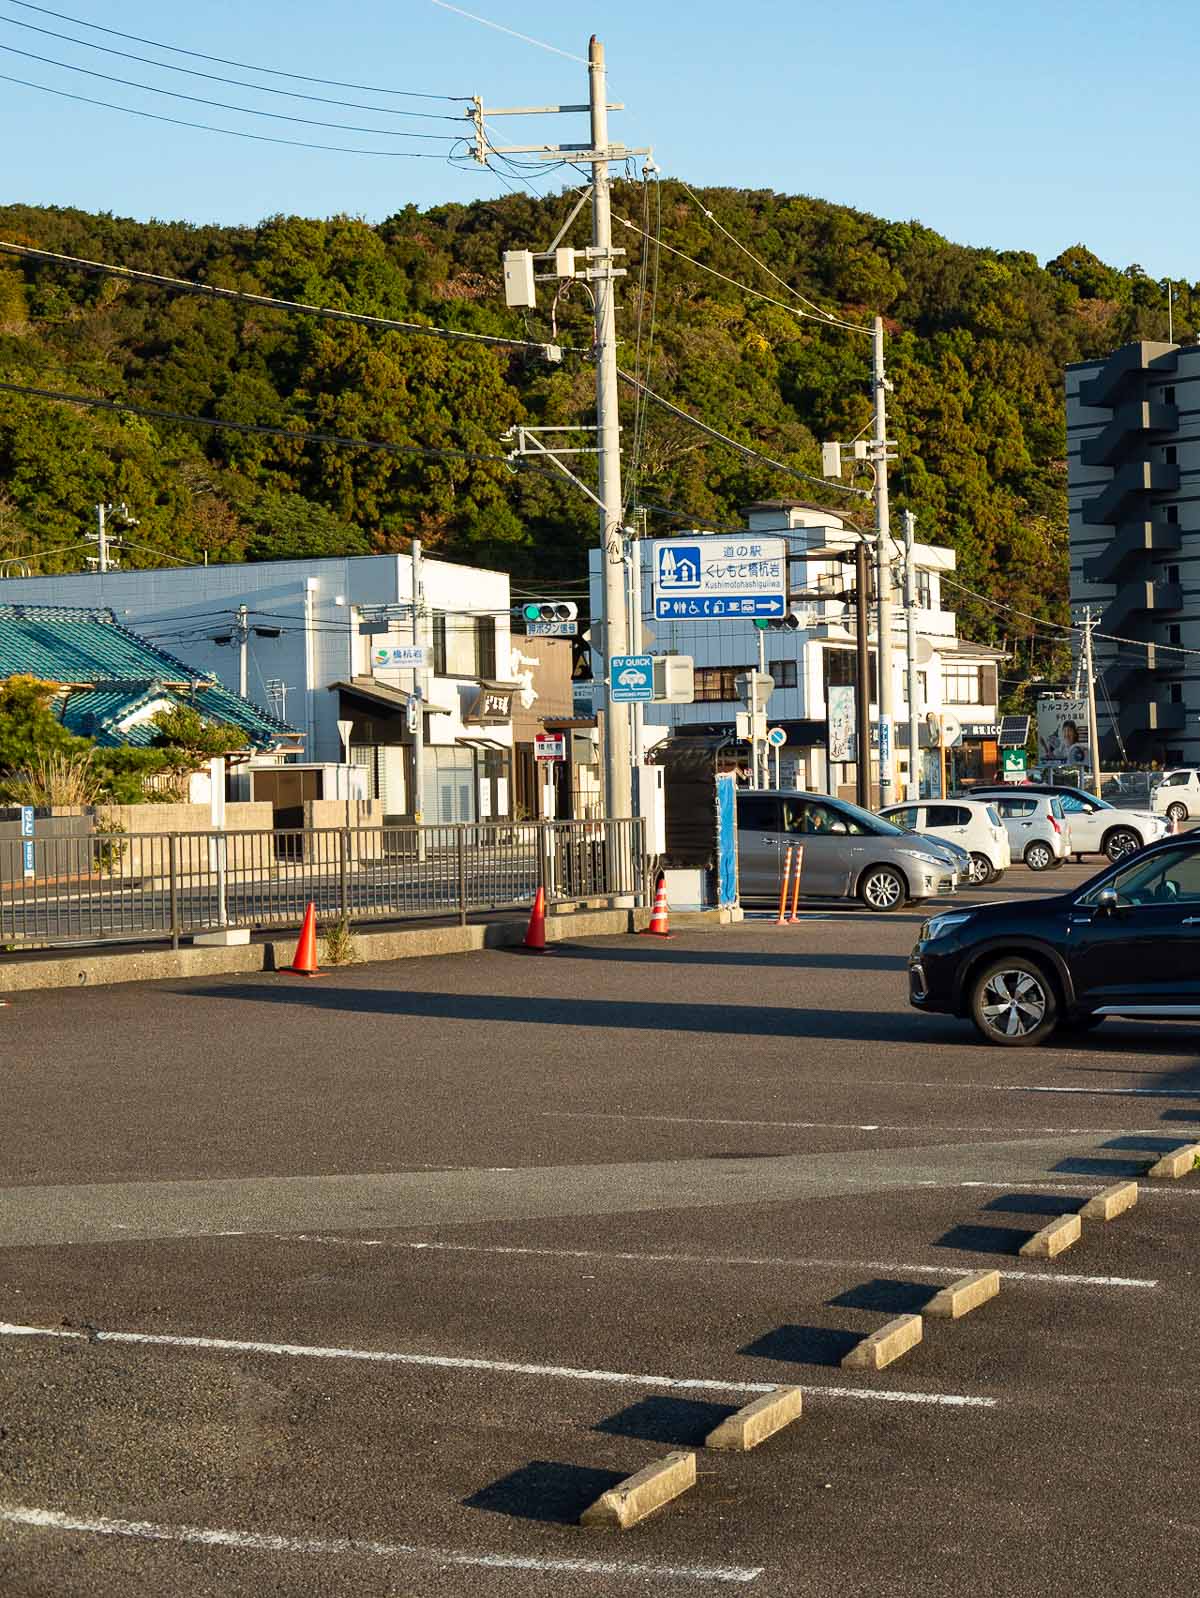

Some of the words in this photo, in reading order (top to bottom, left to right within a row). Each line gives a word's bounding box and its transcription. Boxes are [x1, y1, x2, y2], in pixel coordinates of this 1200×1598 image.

[724, 545, 762, 557] 道の駅
[706, 561, 780, 578] くしもと橋杭岩
[613, 659, 624, 667] EV
[626, 658, 651, 666] QUICK
[1041, 702, 1084, 712] トルコランプ
